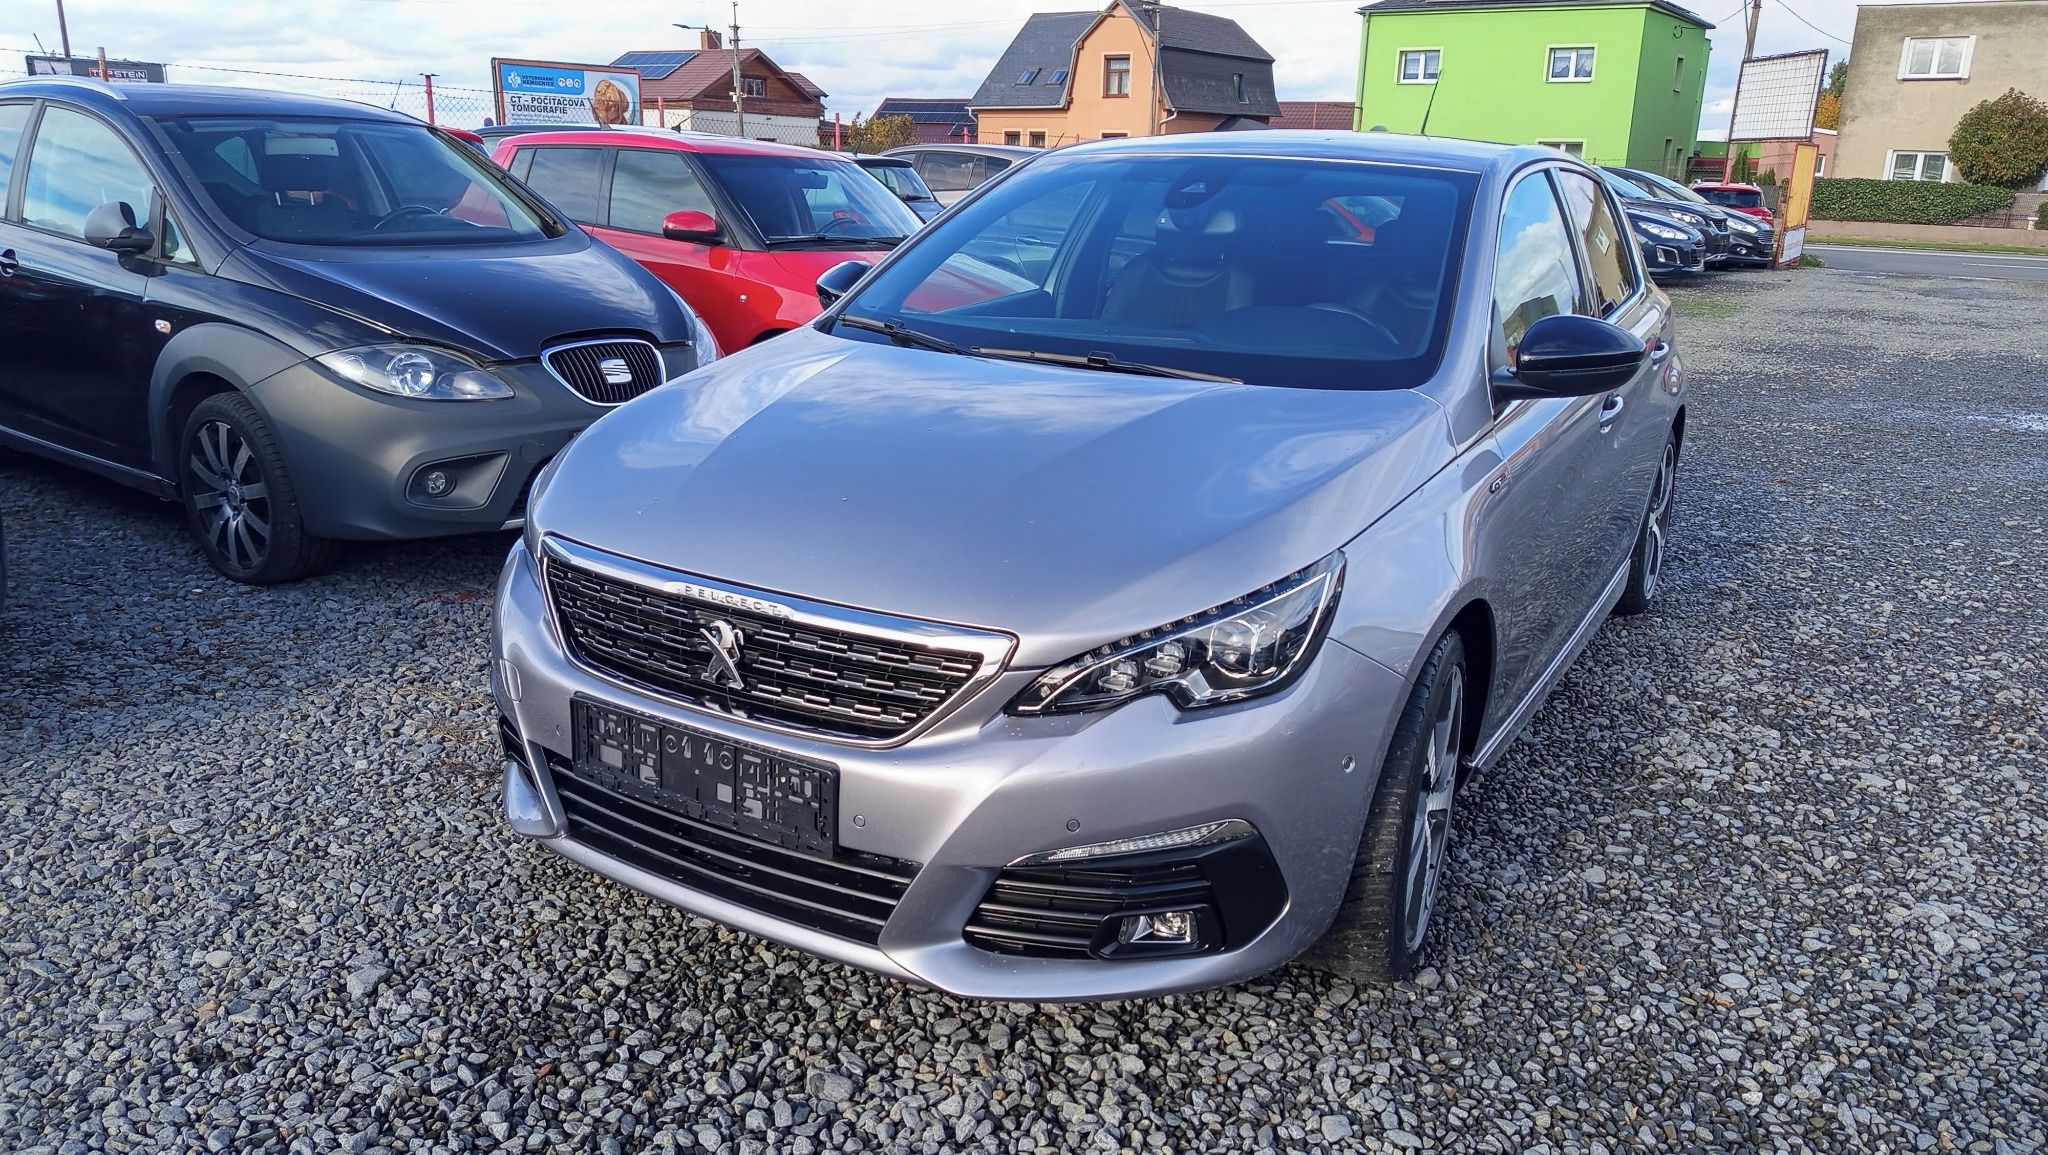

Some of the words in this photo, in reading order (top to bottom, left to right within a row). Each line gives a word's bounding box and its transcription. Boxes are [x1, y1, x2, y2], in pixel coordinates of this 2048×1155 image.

[91, 69, 145, 79] TPSTEIN
[510, 95, 522, 104] CT
[511, 103, 568, 115] TOMOGRAFIE
[685, 585, 778, 615] PEUGEOT
